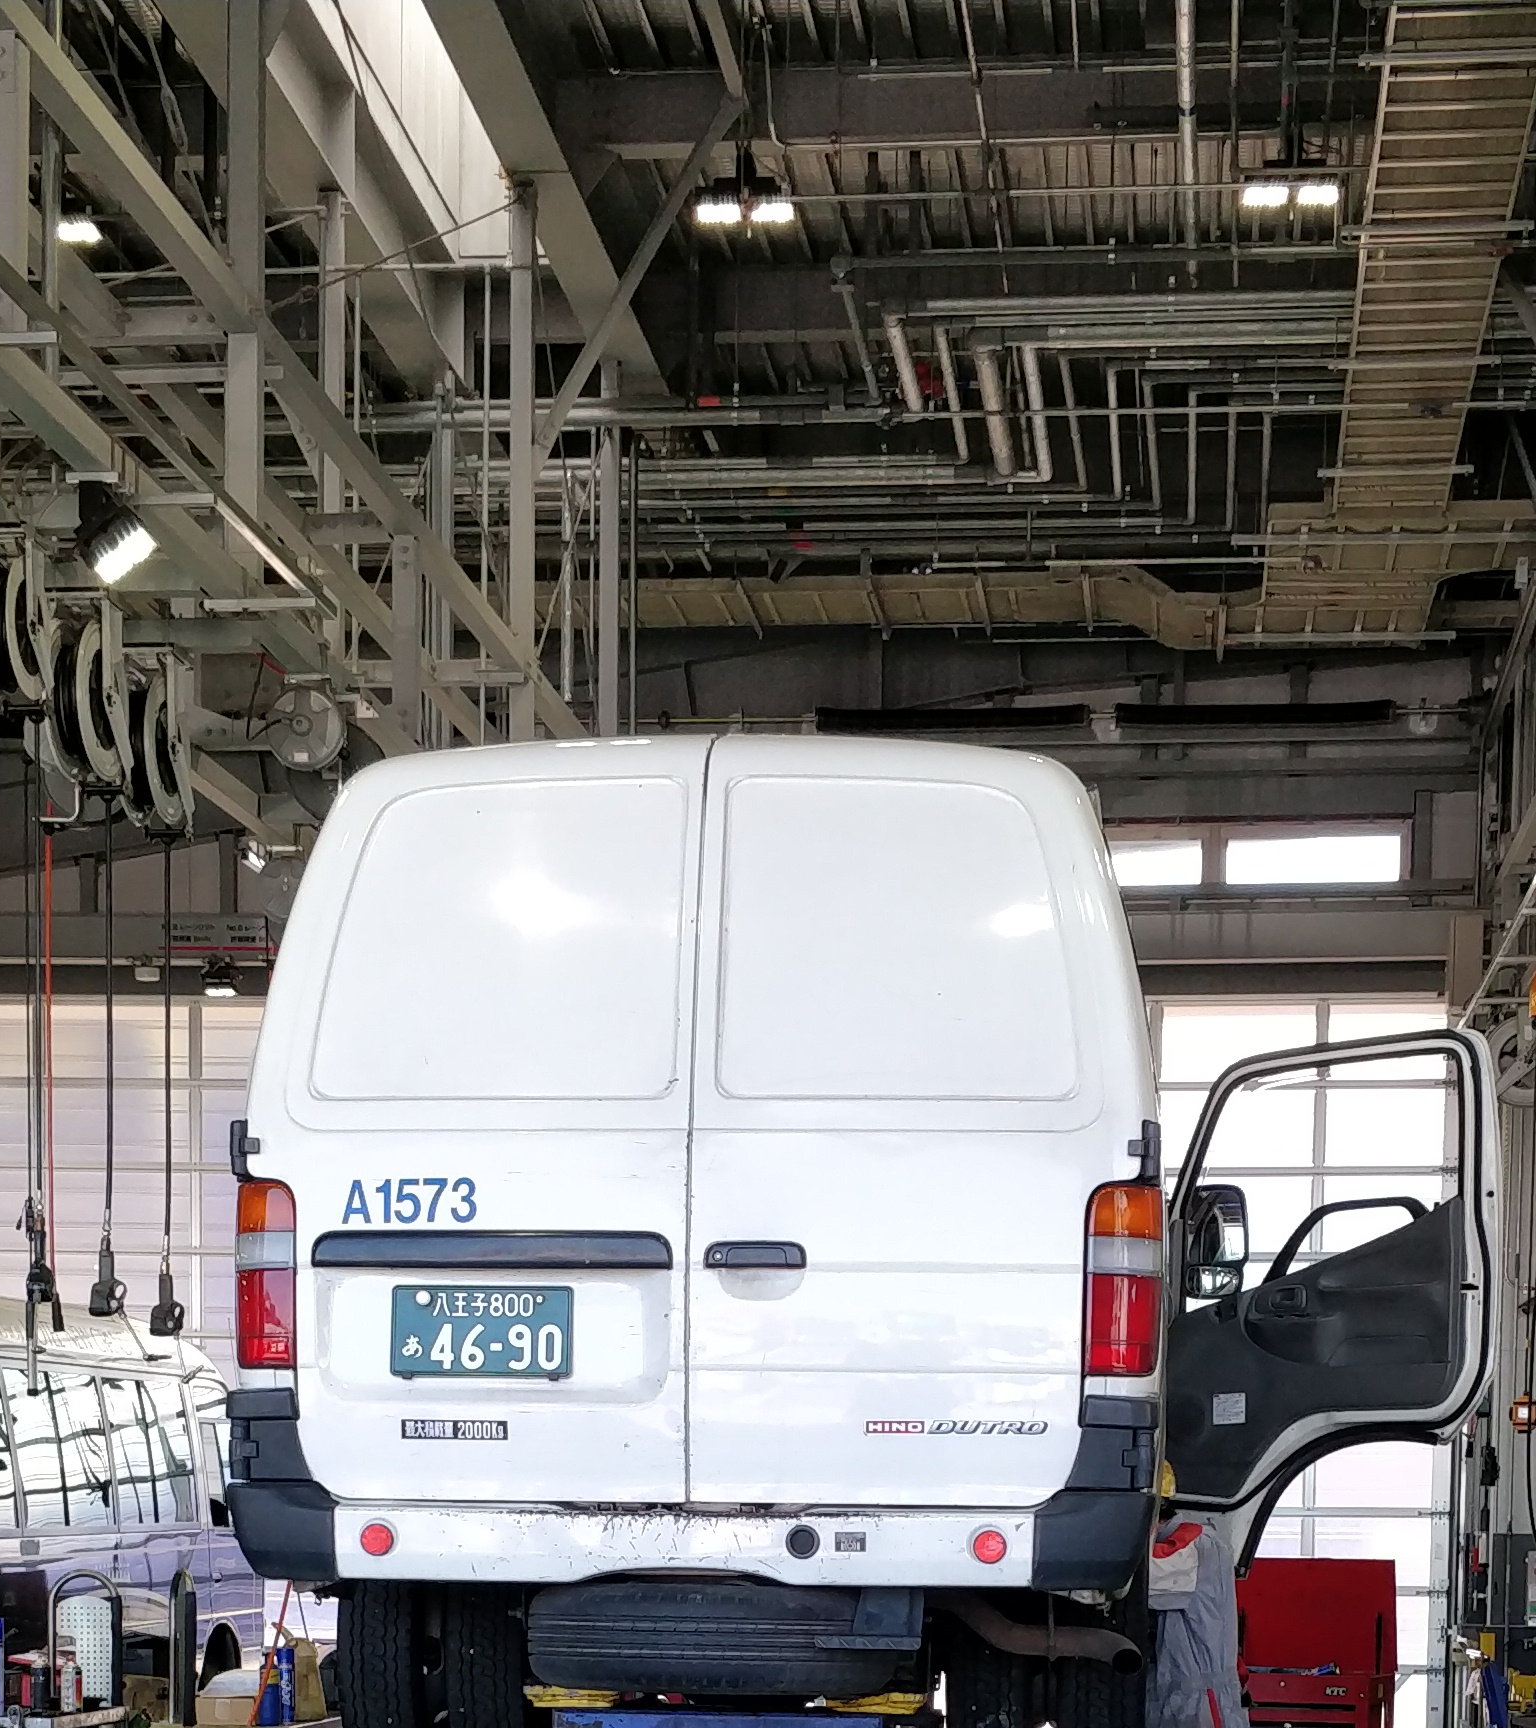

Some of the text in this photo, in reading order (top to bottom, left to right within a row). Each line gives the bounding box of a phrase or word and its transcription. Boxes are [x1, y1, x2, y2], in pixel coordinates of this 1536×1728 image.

[341, 1176, 478, 1225] A1573
[432, 1292, 534, 1317] 八王子800
[401, 1323, 563, 1371] あ 46-90
[868, 1419, 1049, 1435] HINO DUTRO
